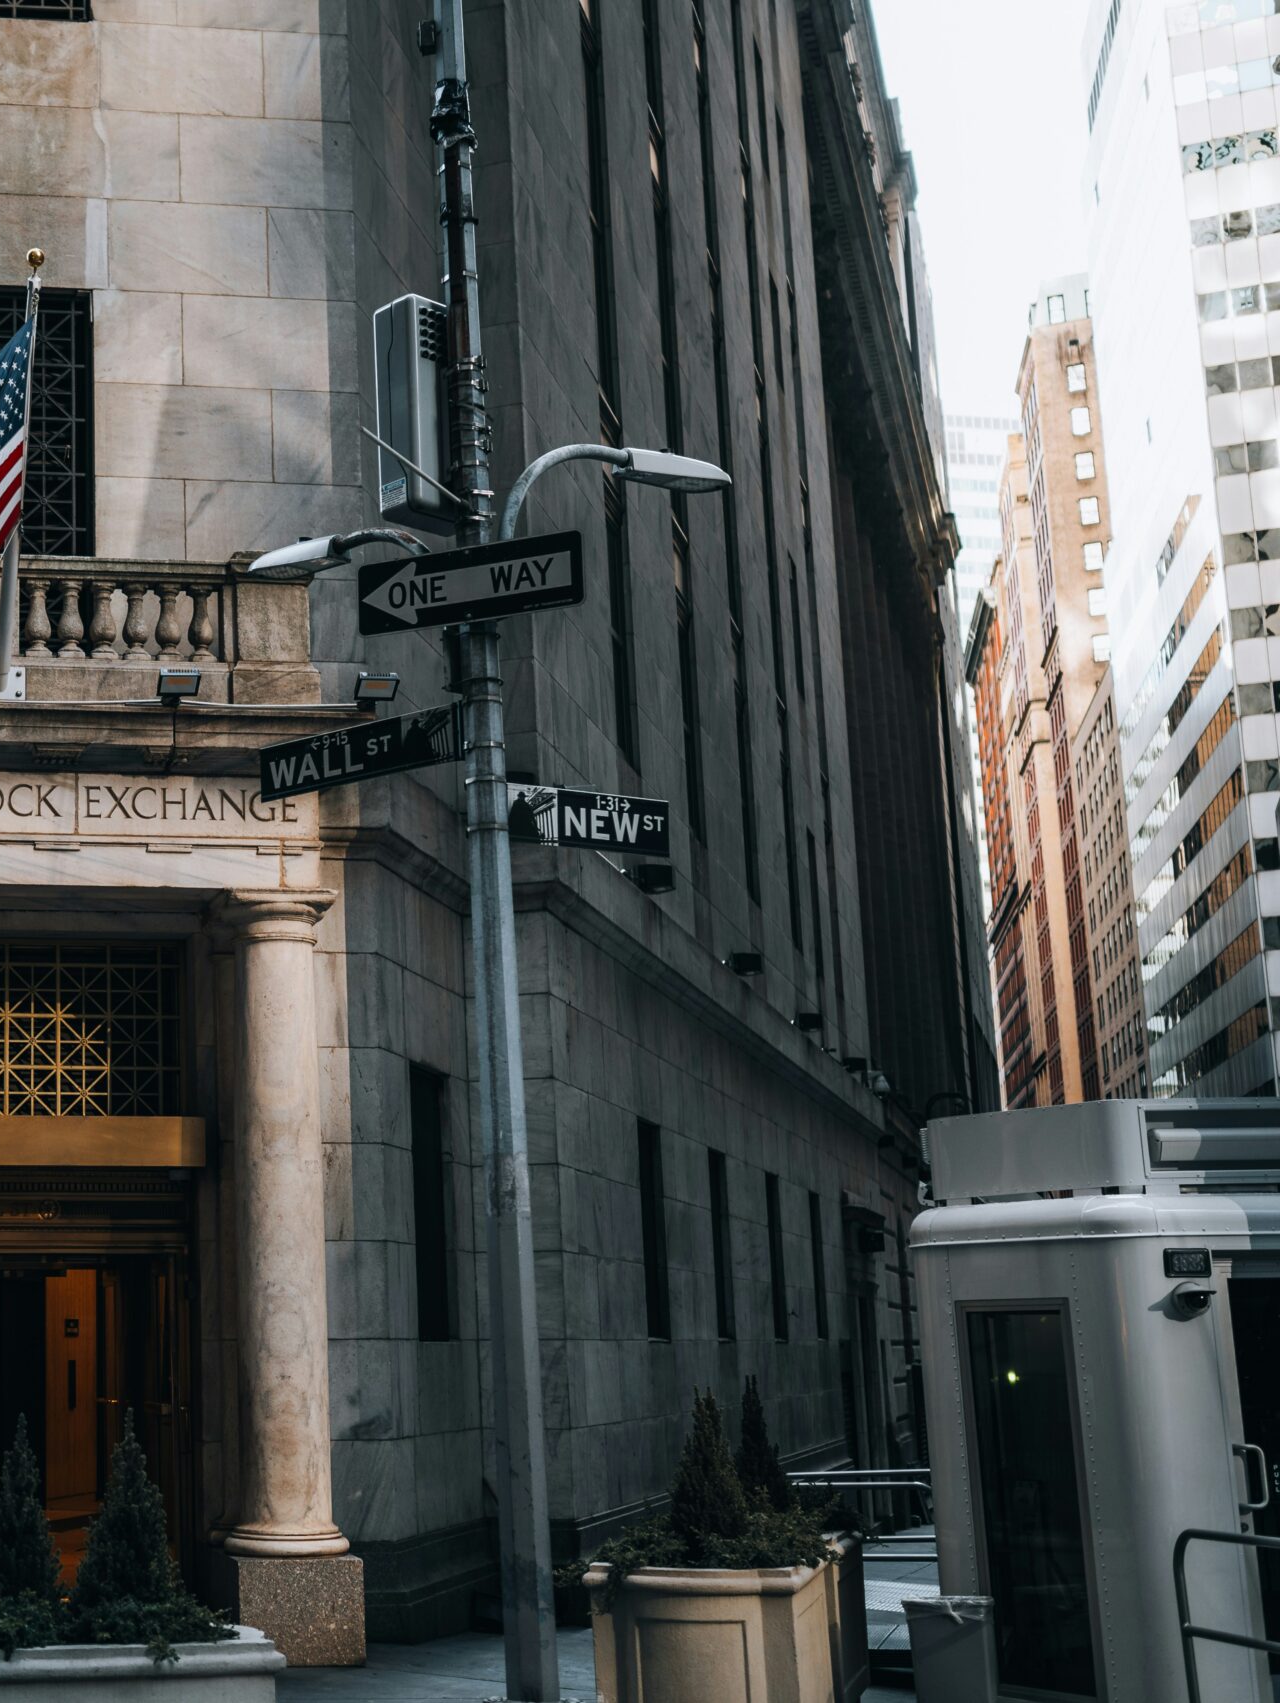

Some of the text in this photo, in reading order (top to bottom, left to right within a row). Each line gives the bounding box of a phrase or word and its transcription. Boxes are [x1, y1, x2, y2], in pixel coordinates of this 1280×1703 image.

[388, 557, 554, 609] ONE WAY
[322, 731, 349, 749] 9-15
[269, 735, 391, 789] WALL ST
[83, 785, 298, 822] EXCHANGE
[596, 795, 619, 811] 1-31
[564, 806, 664, 844] NEW ST
